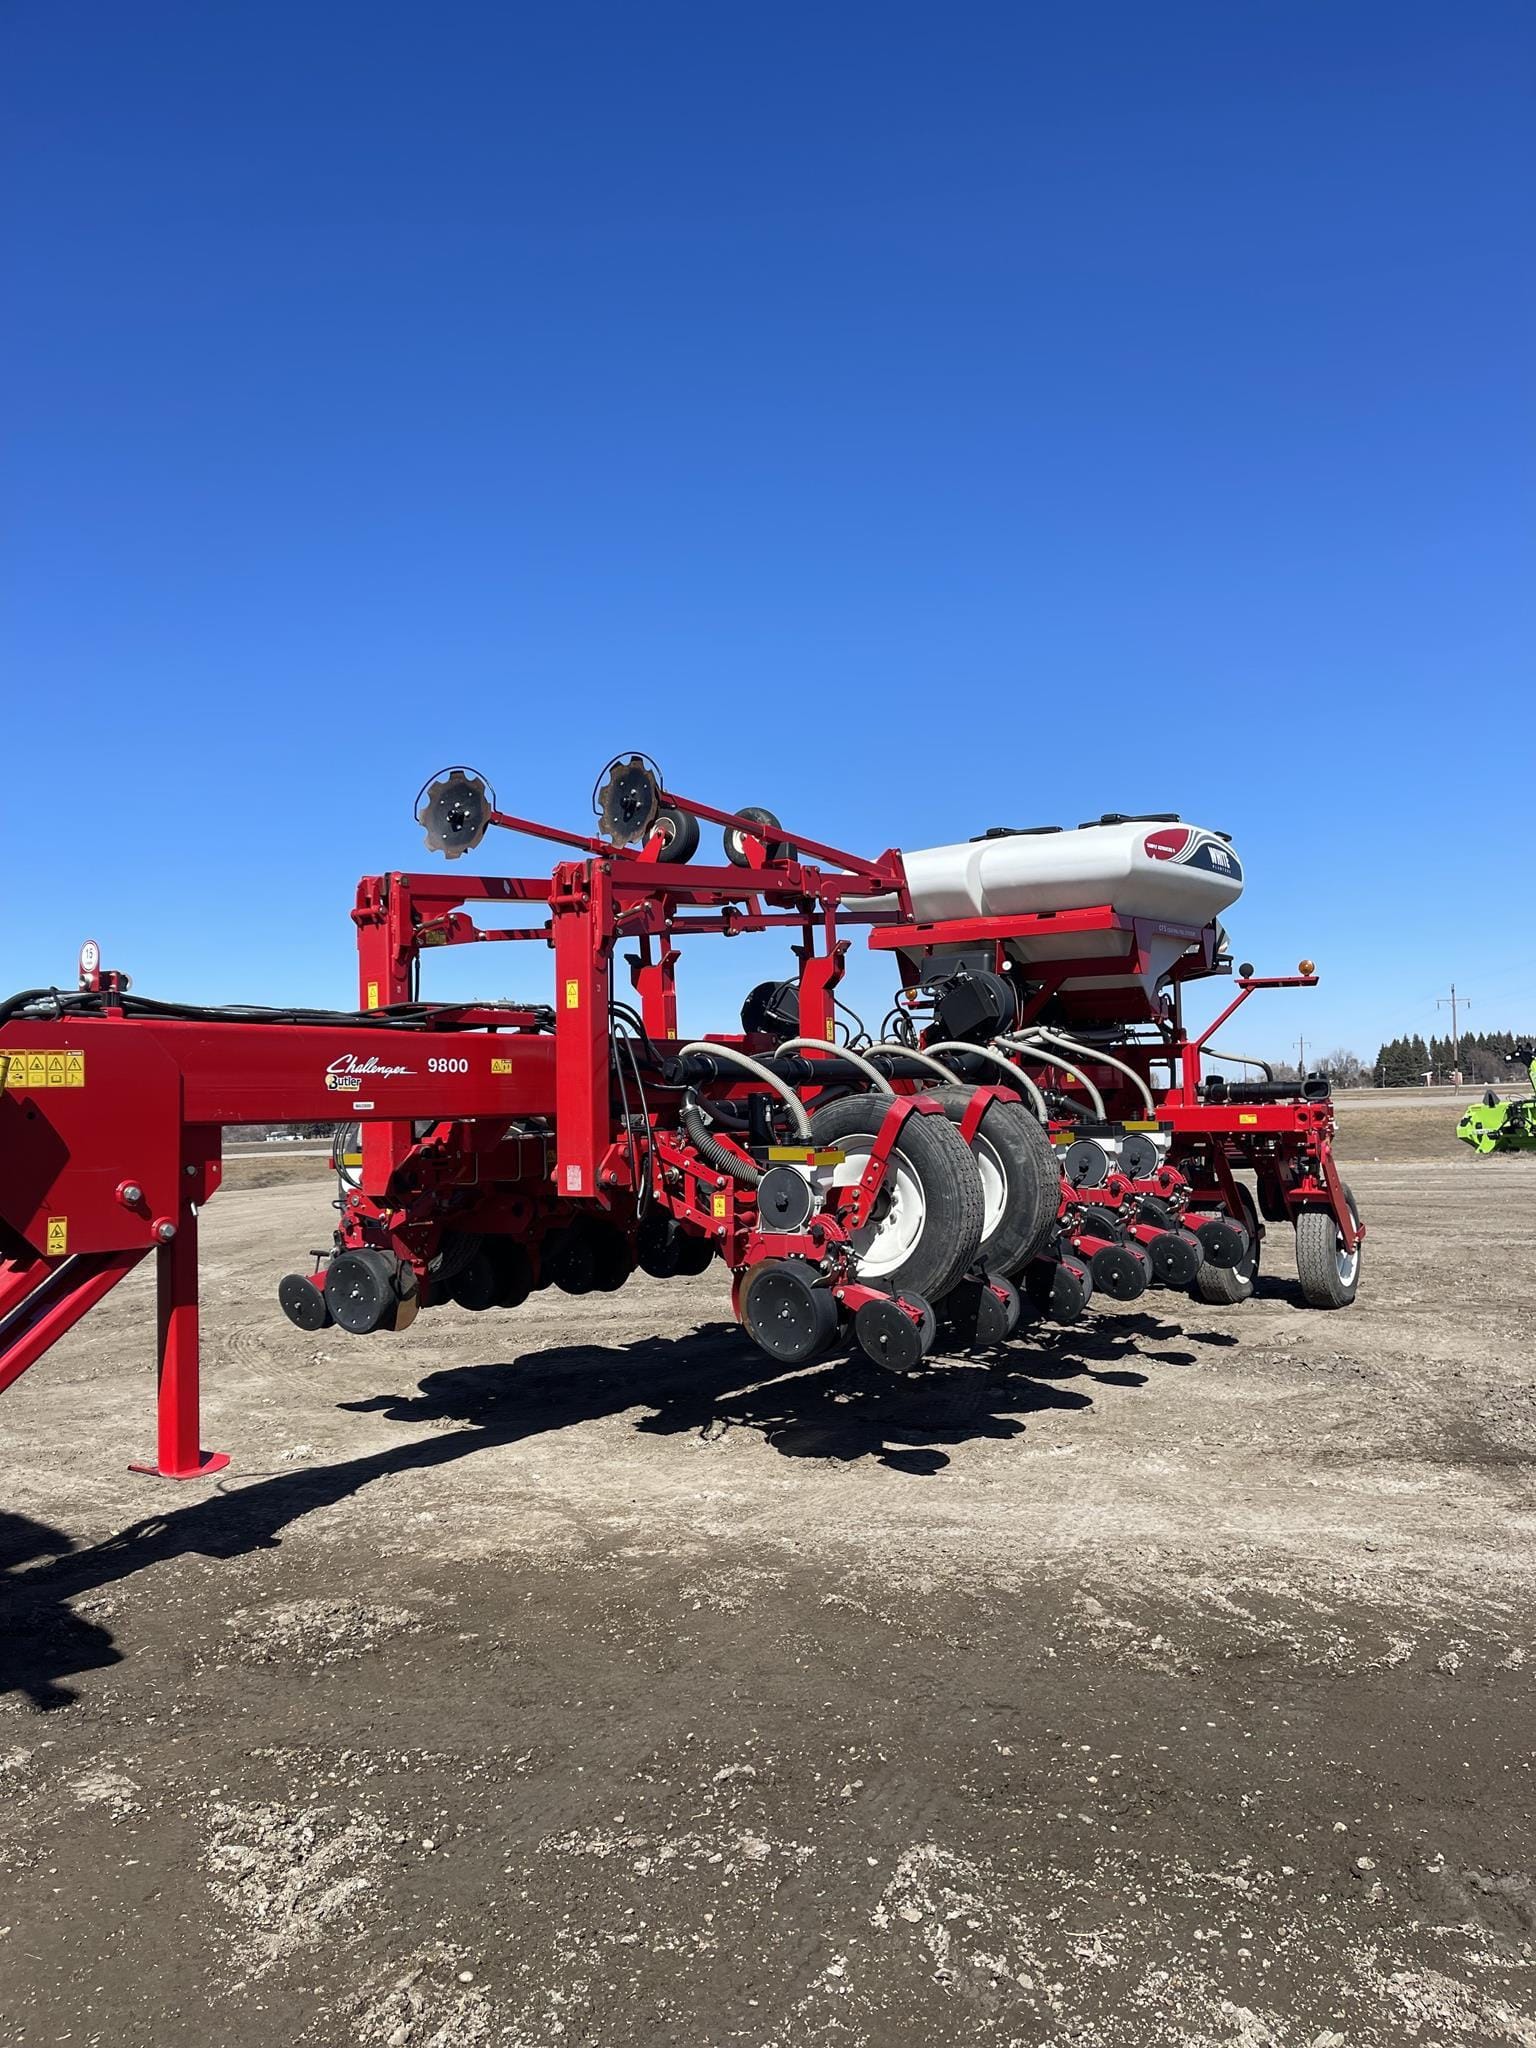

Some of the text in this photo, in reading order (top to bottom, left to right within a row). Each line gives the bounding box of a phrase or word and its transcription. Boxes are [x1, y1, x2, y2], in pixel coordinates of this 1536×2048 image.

[1207, 845, 1231, 869] WHITE
[326, 1053, 469, 1079] Challenger 9800
[328, 1074, 361, 1090] Butler
